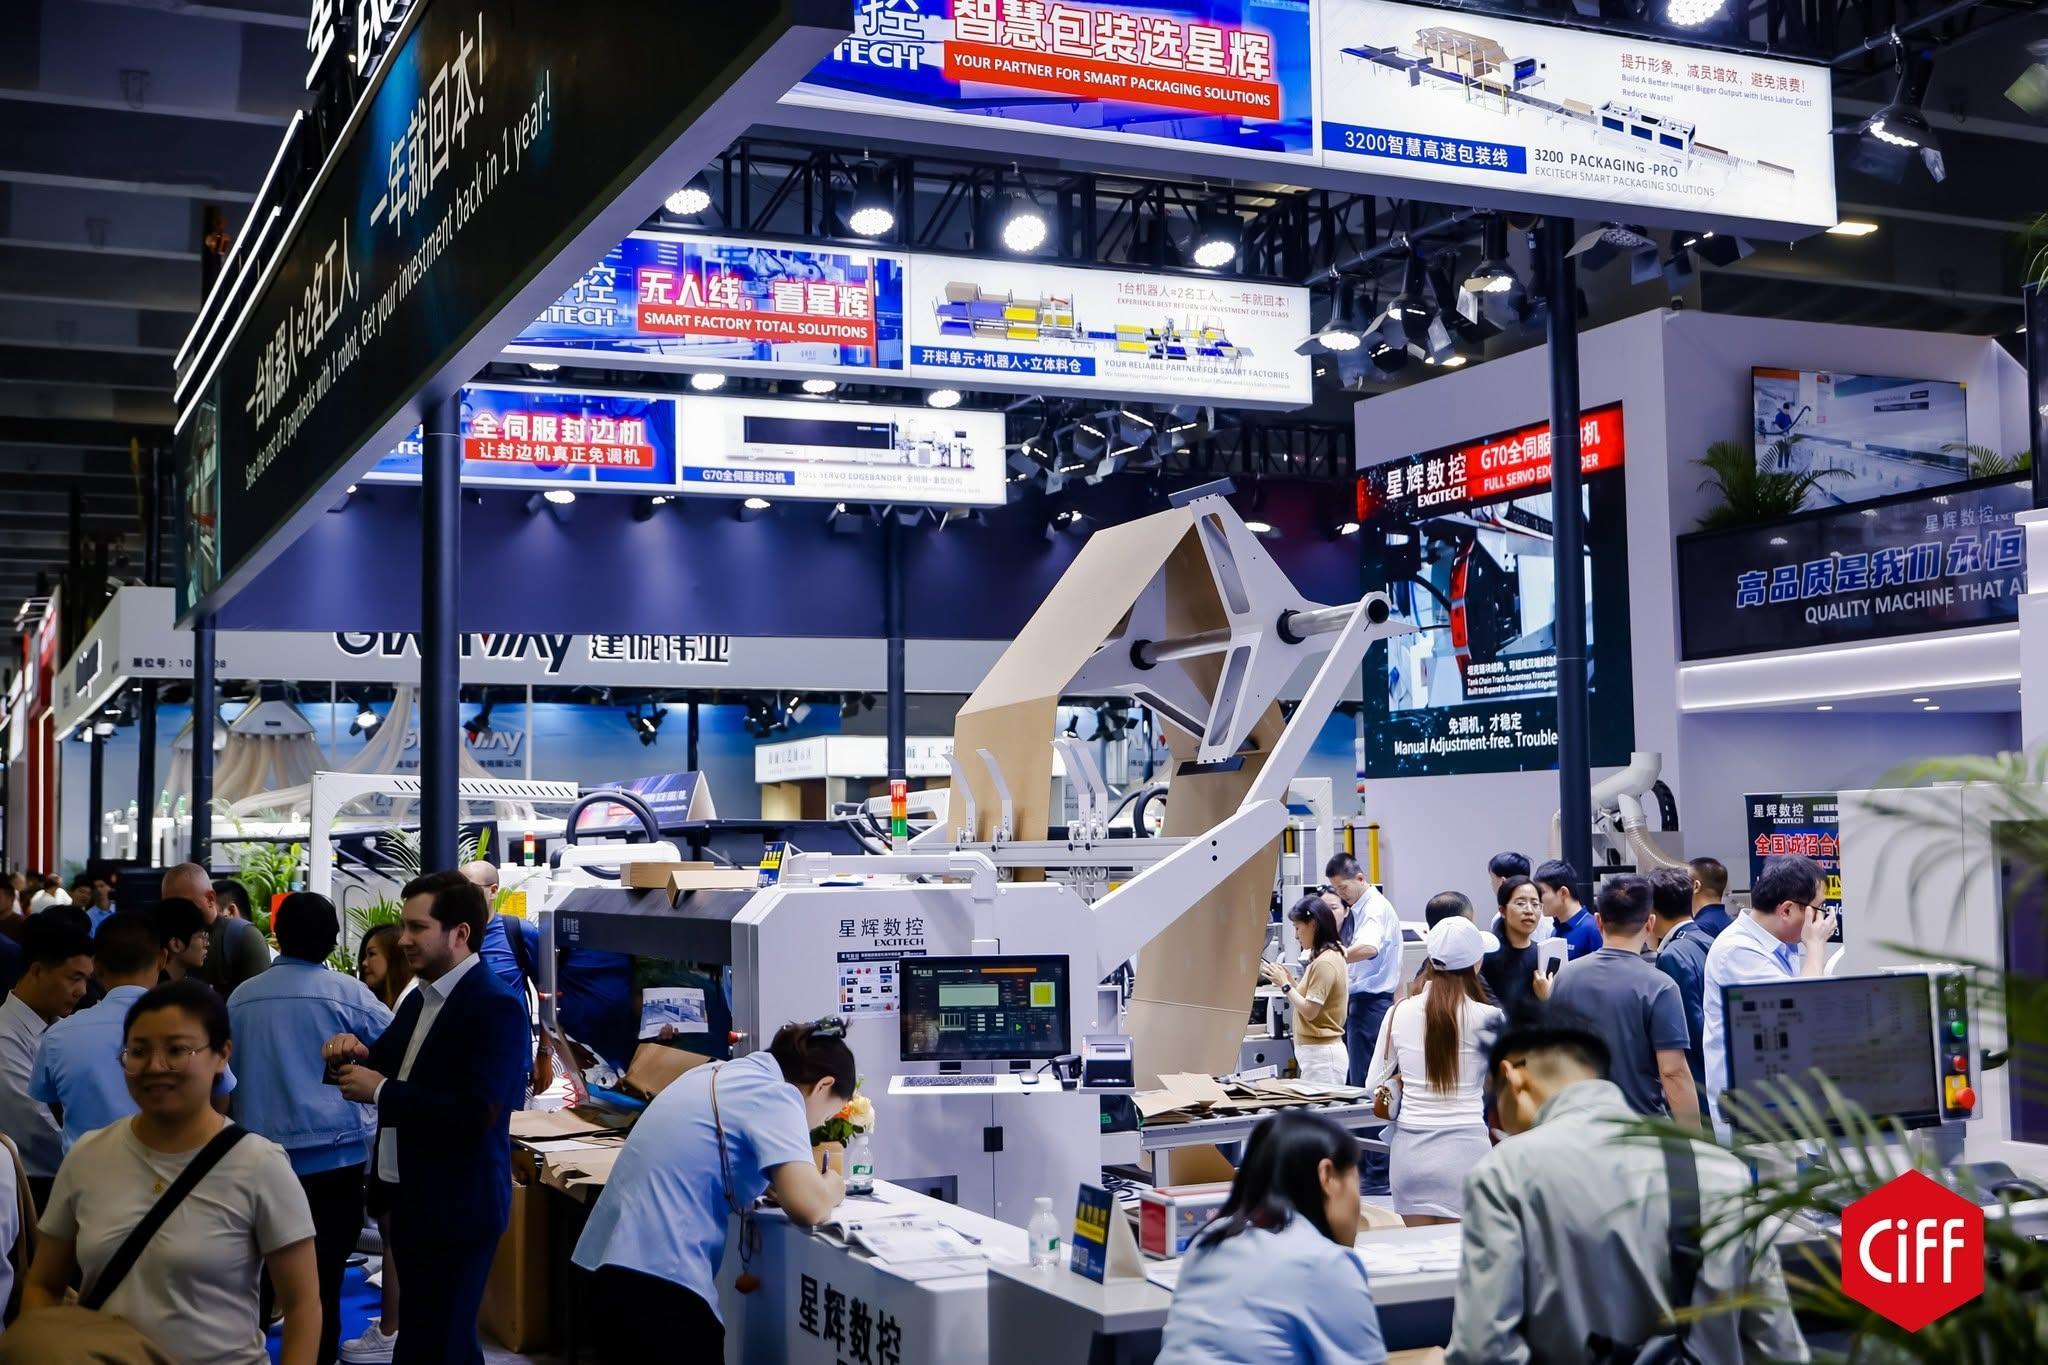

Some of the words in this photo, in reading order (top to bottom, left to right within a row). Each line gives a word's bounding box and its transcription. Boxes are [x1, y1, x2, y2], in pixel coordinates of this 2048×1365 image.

[953, 0, 1271, 81] 智慧包装选星辉
[954, 53, 991, 69] YOUR
[994, 57, 1053, 78] PARTNER
[1056, 64, 1080, 81] FOR
[1083, 70, 1127, 88] SMART
[1131, 77, 1201, 97] PACKAGING
[1205, 87, 1270, 107] SOLUTIONS
[1621, 73, 1640, 84] Build
[1641, 76, 1647, 84] A
[1648, 78, 1669, 88] Better
[1696, 84, 1717, 95] Bigger
[1719, 87, 1742, 98] Output
[1744, 90, 1759, 99] with
[1760, 93, 1775, 102] Less
[1776, 95, 1794, 105] Labor
[1622, 88, 1647, 99] Reduce
[1345, 131, 1508, 168] 3200智慧高速包装线
[1535, 149, 1564, 163] 3200
[1570, 153, 1645, 174] PACKAGING
[1648, 164, 1678, 178] -PRO
[1535, 167, 1579, 180] EXCITECH
[1580, 172, 1611, 184] SMART
[1614, 176, 1664, 191] PACKAGING
[1666, 182, 1715, 197] SOLUTIONS
[316, 357, 331, 402] with
[338, 325, 360, 376] robot,
[361, 302, 377, 346] Get
[378, 280, 397, 336] your
[399, 204, 453, 302] investment
[456, 161, 483, 231] back
[486, 150, 498, 195] in
[503, 127, 510, 175] 1
[514, 69, 550, 173] year!
[644, 311, 691, 327] SMART
[693, 314, 753, 331] FACTORY
[756, 318, 795, 334] TOTAL
[798, 322, 867, 339] SOLUTIONS
[922, 349, 1082, 373] 开料单元+机器人+立体料仓
[1104, 359, 1127, 369] YOUR
[1129, 361, 1164, 371] RELIABLE
[1166, 364, 1201, 374] PARTNER
[1203, 366, 1218, 375] FOR
[1220, 368, 1247, 377] SMART
[1248, 370, 1290, 380] FACTORIES
[472, 411, 645, 446] 全伺服封边机
[479, 443, 640, 465] 让封边机真正免调机
[1386, 452, 1468, 500] 星辉数控
[1484, 478, 1505, 491] FULL
[1506, 468, 1535, 487] SERVO
[1417, 485, 1467, 508] EXCITECH
[1924, 504, 1994, 534] 星辉数控
[1805, 600, 1870, 625] QUALITY
[1875, 587, 1955, 615] MACHINE
[1959, 579, 2004, 603] THAT
[1448, 712, 1523, 735] 免调机，才稳定
[1394, 738, 1429, 756] Manual
[1430, 732, 1514, 757] Adjustment-free.
[1753, 803, 1804, 818] 星辉数控
[839, 917, 924, 938] 星辉数控
[874, 938, 924, 947] EXCITECH
[799, 1273, 902, 1365] 星辉数控
